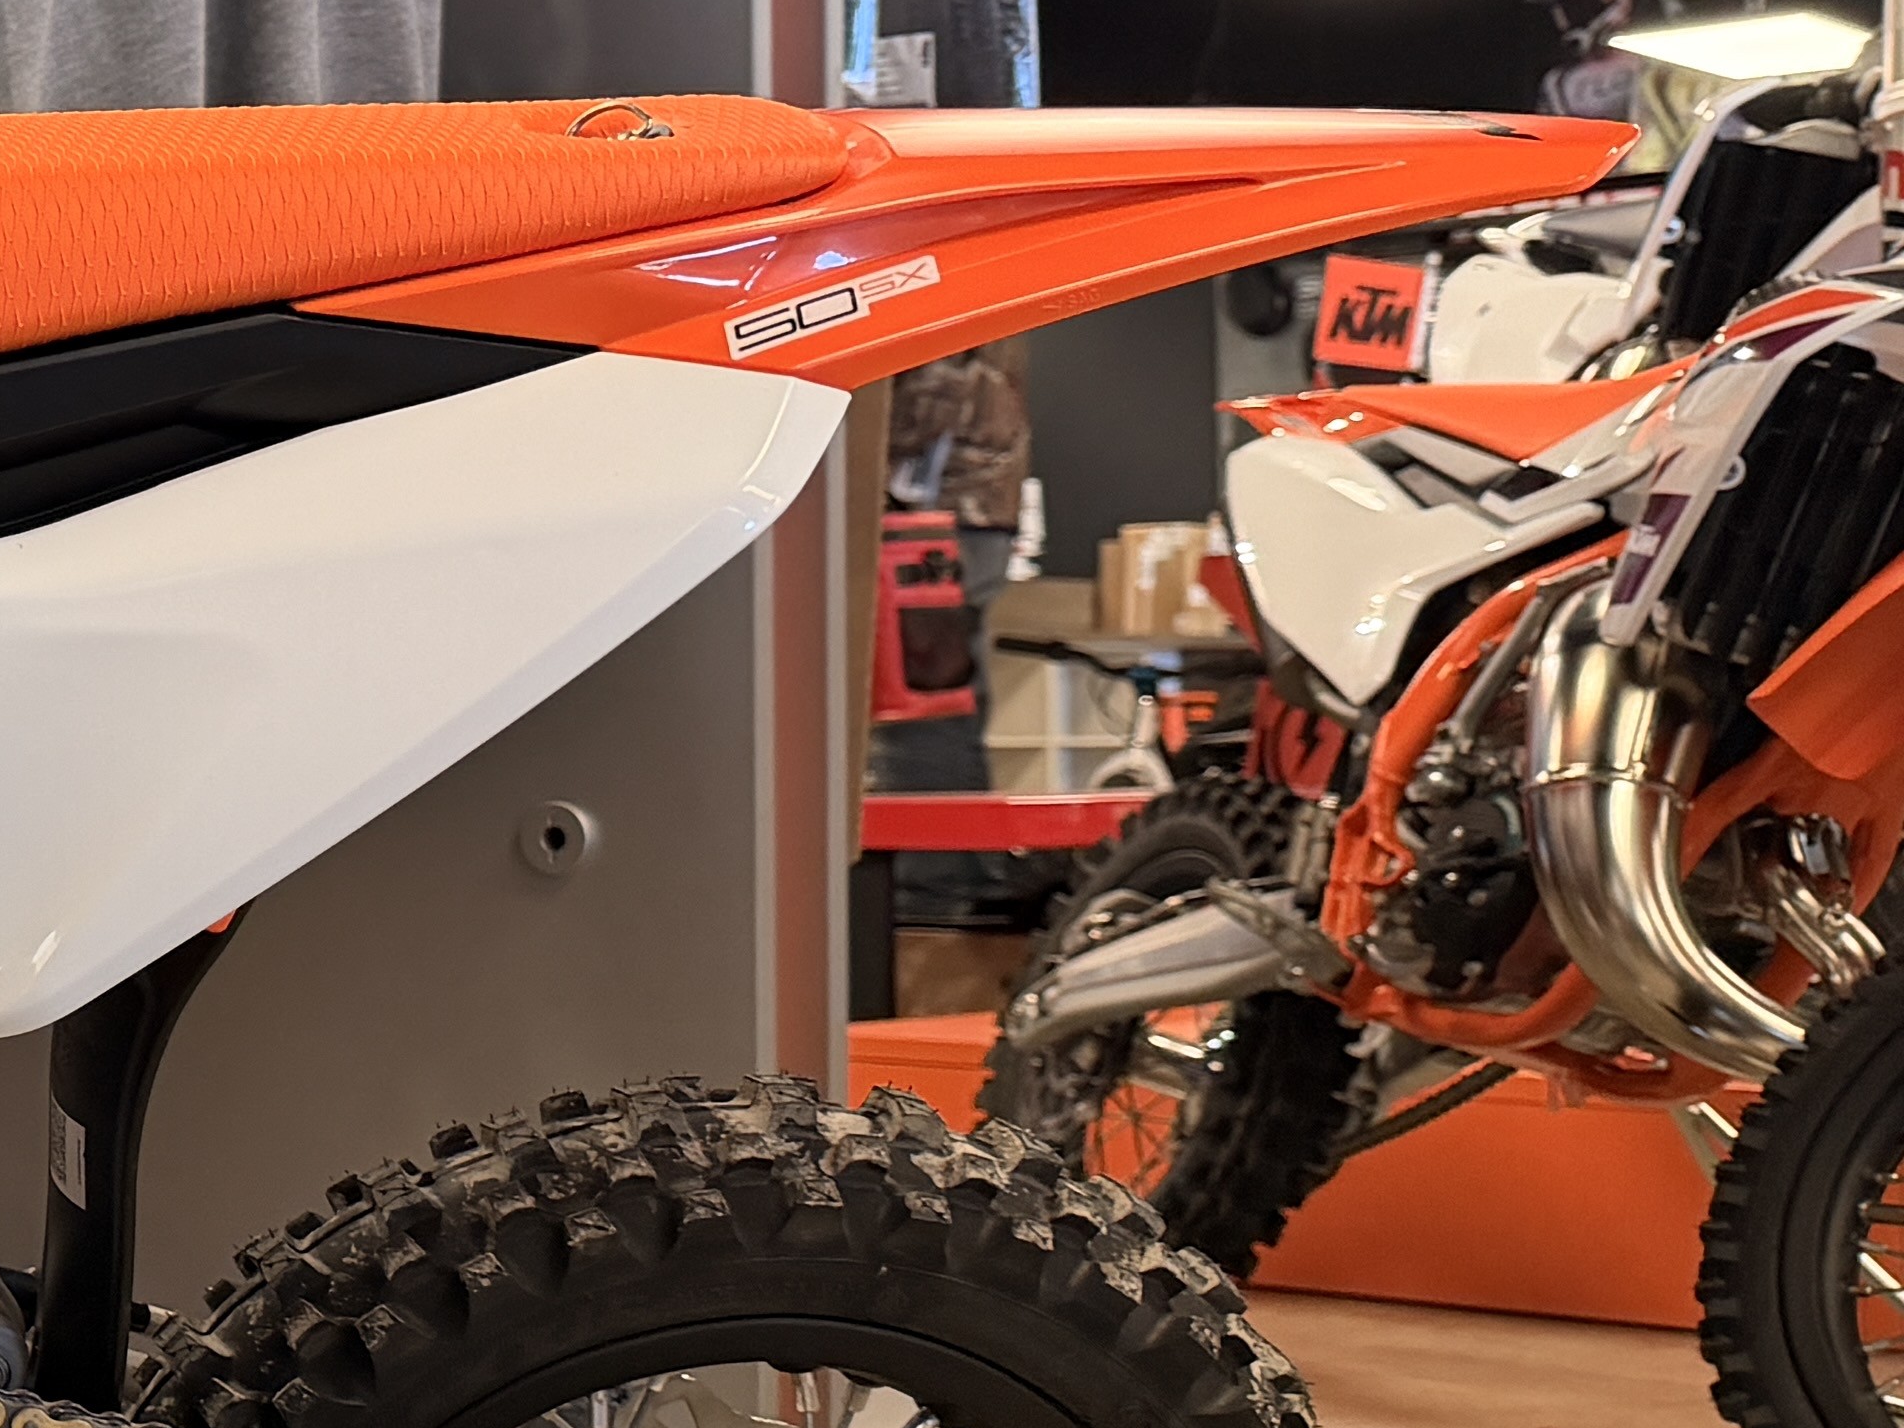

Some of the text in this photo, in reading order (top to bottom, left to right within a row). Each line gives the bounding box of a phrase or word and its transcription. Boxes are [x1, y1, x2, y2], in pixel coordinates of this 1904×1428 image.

[734, 262, 930, 351] 50 SX
[1328, 285, 1413, 347] KTM
